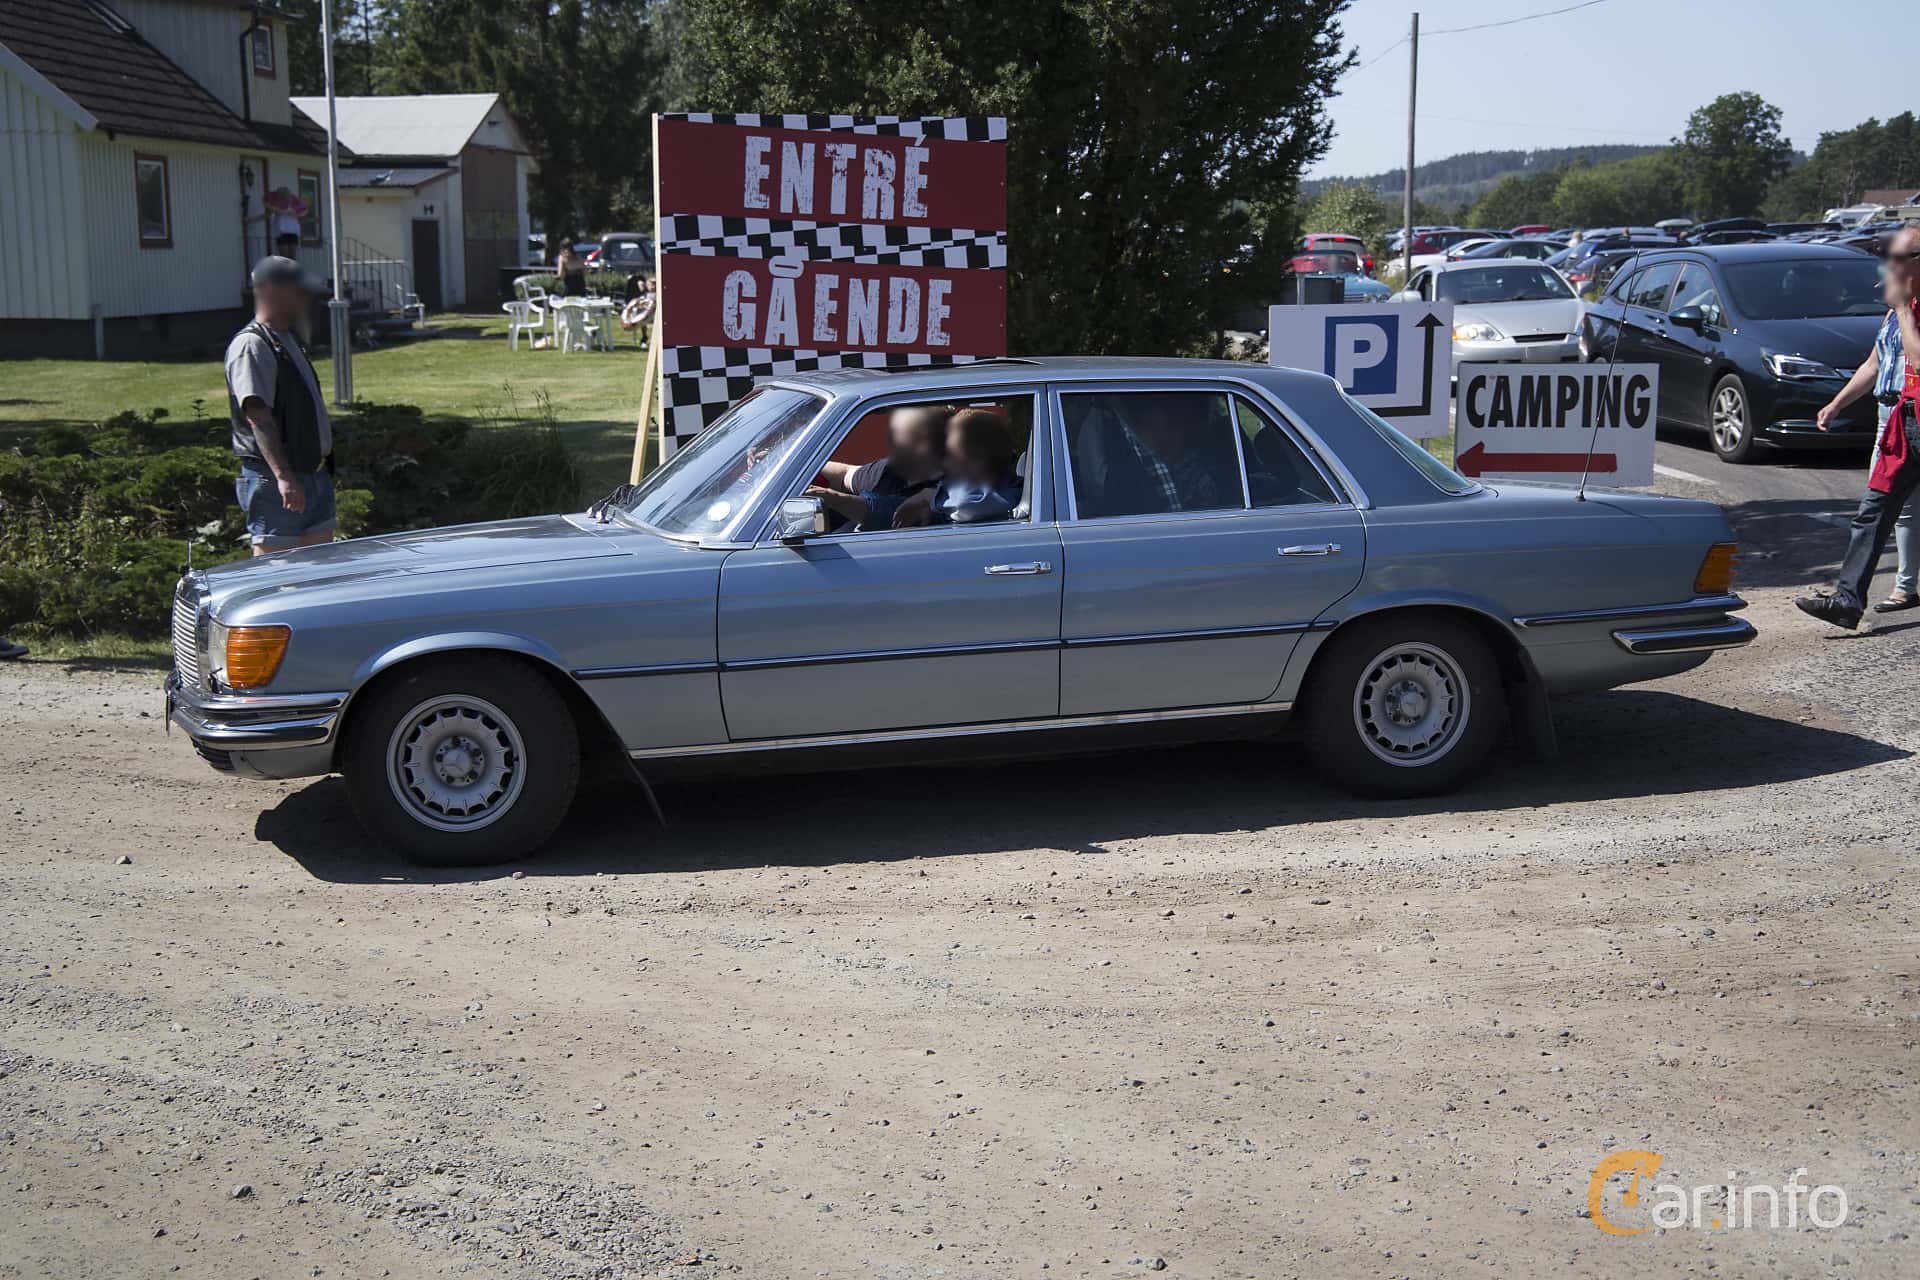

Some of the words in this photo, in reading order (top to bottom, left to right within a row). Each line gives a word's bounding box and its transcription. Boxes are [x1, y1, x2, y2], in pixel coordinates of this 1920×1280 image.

[744, 134, 930, 220] ENTRÉ
[722, 255, 952, 346] GÅENDE
[1334, 322, 1389, 388] P
[1465, 373, 1652, 429] CAMPING
